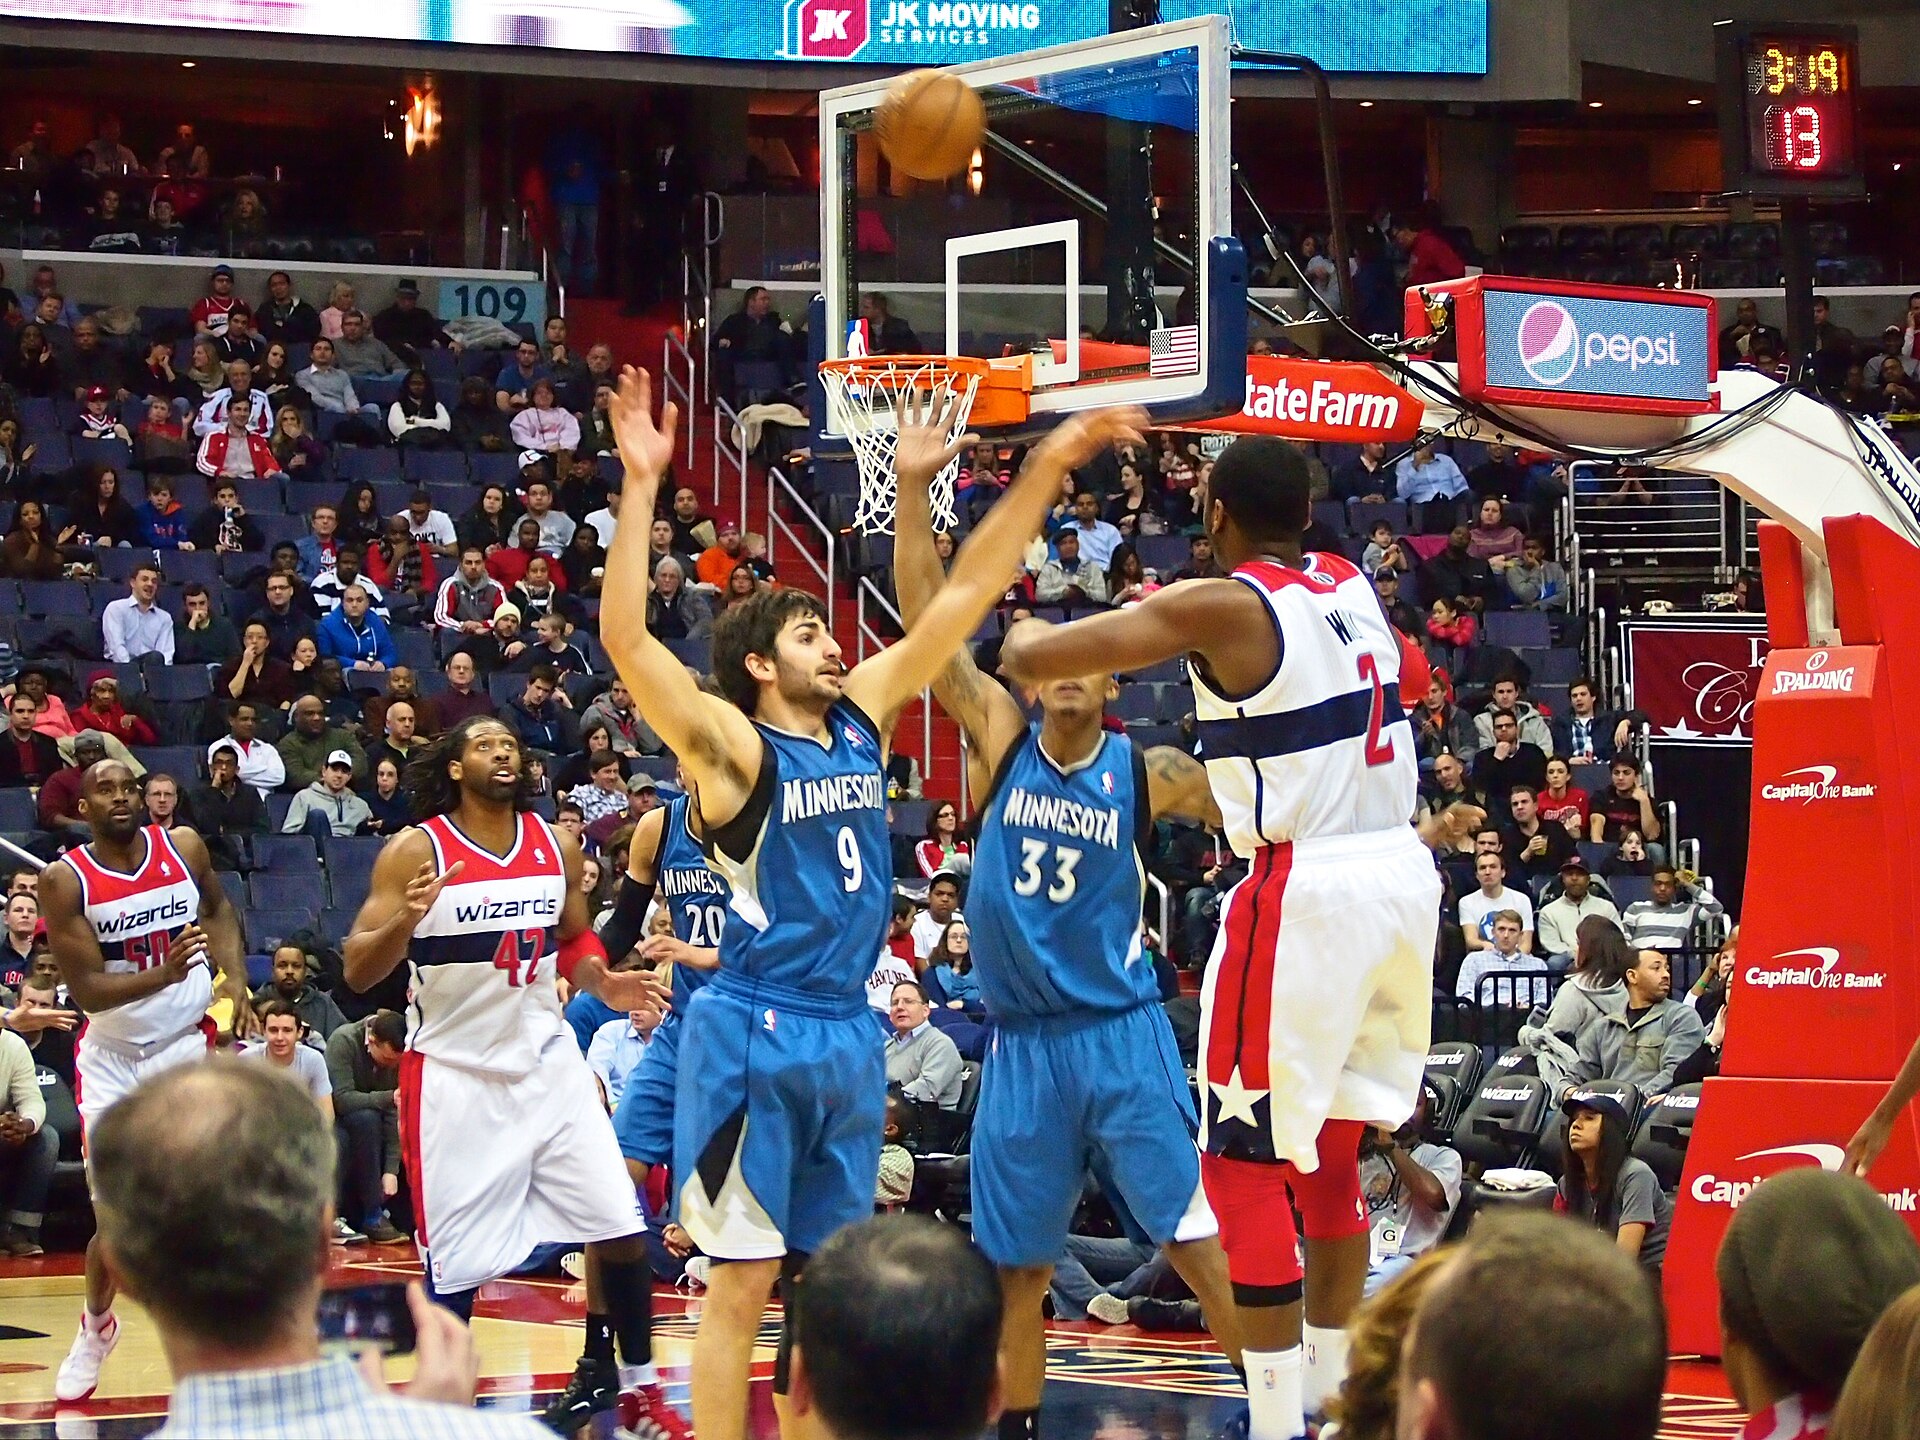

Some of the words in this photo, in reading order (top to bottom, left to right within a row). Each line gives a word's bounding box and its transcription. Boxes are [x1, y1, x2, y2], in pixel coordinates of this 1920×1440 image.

[809, 9, 852, 42] JK
[880, 1, 920, 27] JK
[928, 2, 1040, 30] MOVING
[880, 29, 989, 45] SERVICES
[1766, 48, 1839, 95] 3:19
[1784, 106, 1822, 167] 13
[454, 284, 527, 323] 109
[1584, 330, 1678, 372] pepsi
[1243, 374, 1399, 429] tateFarm
[1862, 440, 1920, 526] SPALDI
[1771, 667, 1855, 695] SPALDING
[1357, 651, 1395, 768] 2
[1842, 785, 1875, 798] Bank
[1003, 787, 1120, 851] MINNESOTA
[837, 825, 863, 893] 9
[1014, 836, 1084, 903] 33
[97, 894, 188, 934] wizards
[456, 888, 557, 923] wizards
[685, 903, 727, 946] 20
[493, 926, 546, 988] 42
[1843, 973, 1883, 988] Bank
[1480, 1083, 1533, 1101] wizards
[1382, 1229, 1396, 1242] G
